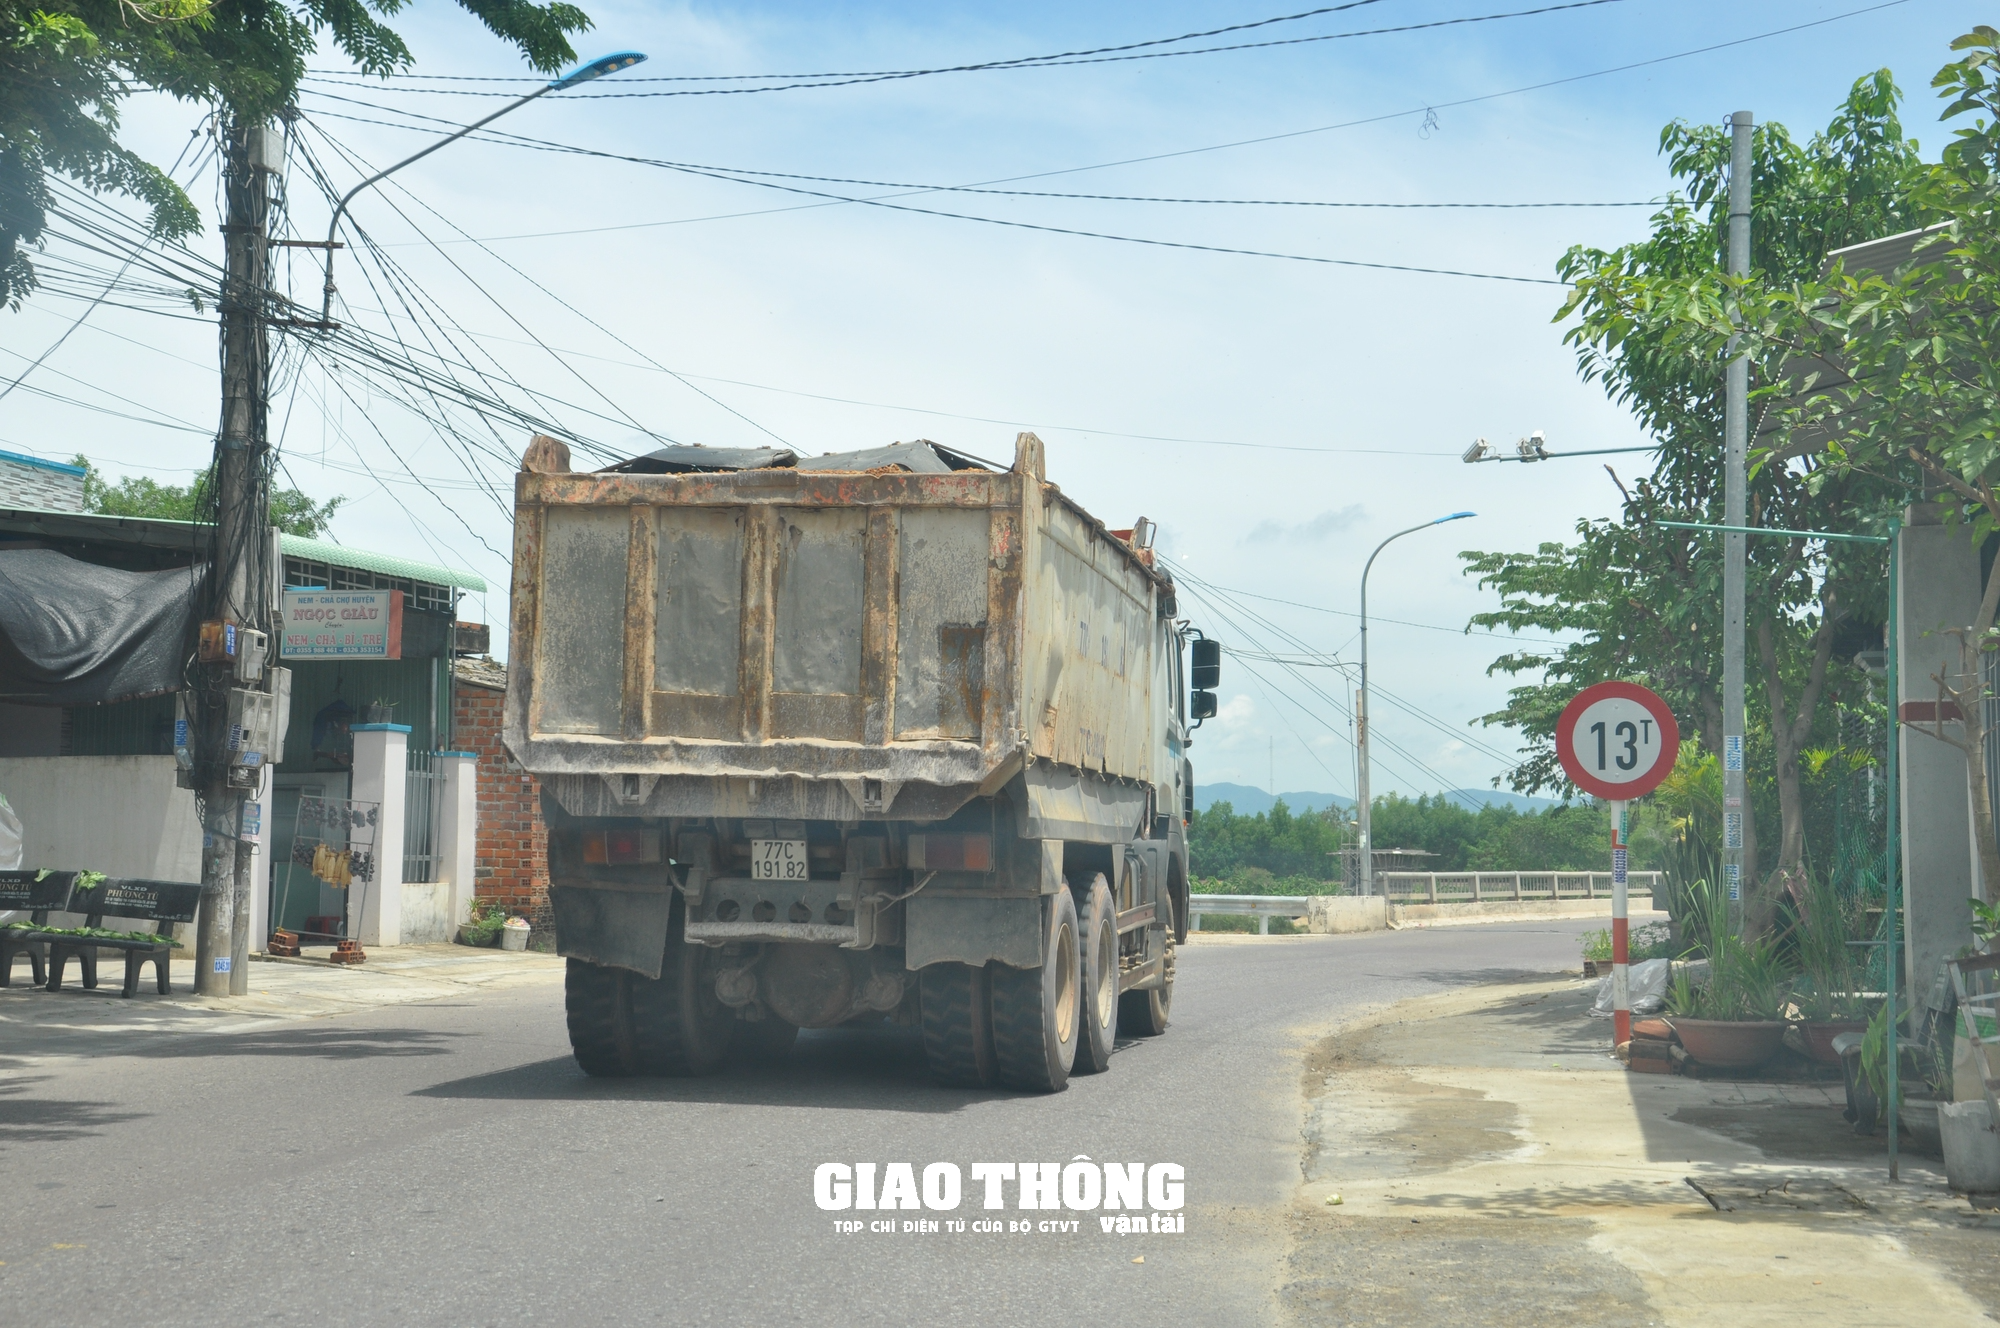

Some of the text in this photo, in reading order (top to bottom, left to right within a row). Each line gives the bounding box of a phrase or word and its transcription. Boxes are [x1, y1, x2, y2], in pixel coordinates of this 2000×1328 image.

[320, 596, 335, 604] CHẢ
[336, 597, 351, 605] CHỢ
[352, 596, 375, 604] HUYỆN
[293, 605, 379, 622] NGỌC GIÀU
[286, 635, 308, 645] NEM
[316, 630, 336, 645] CHẢ
[764, 841, 793, 859] 77C
[754, 860, 806, 878] 191.82
[107, 889, 145, 900] PHƯƠNG
